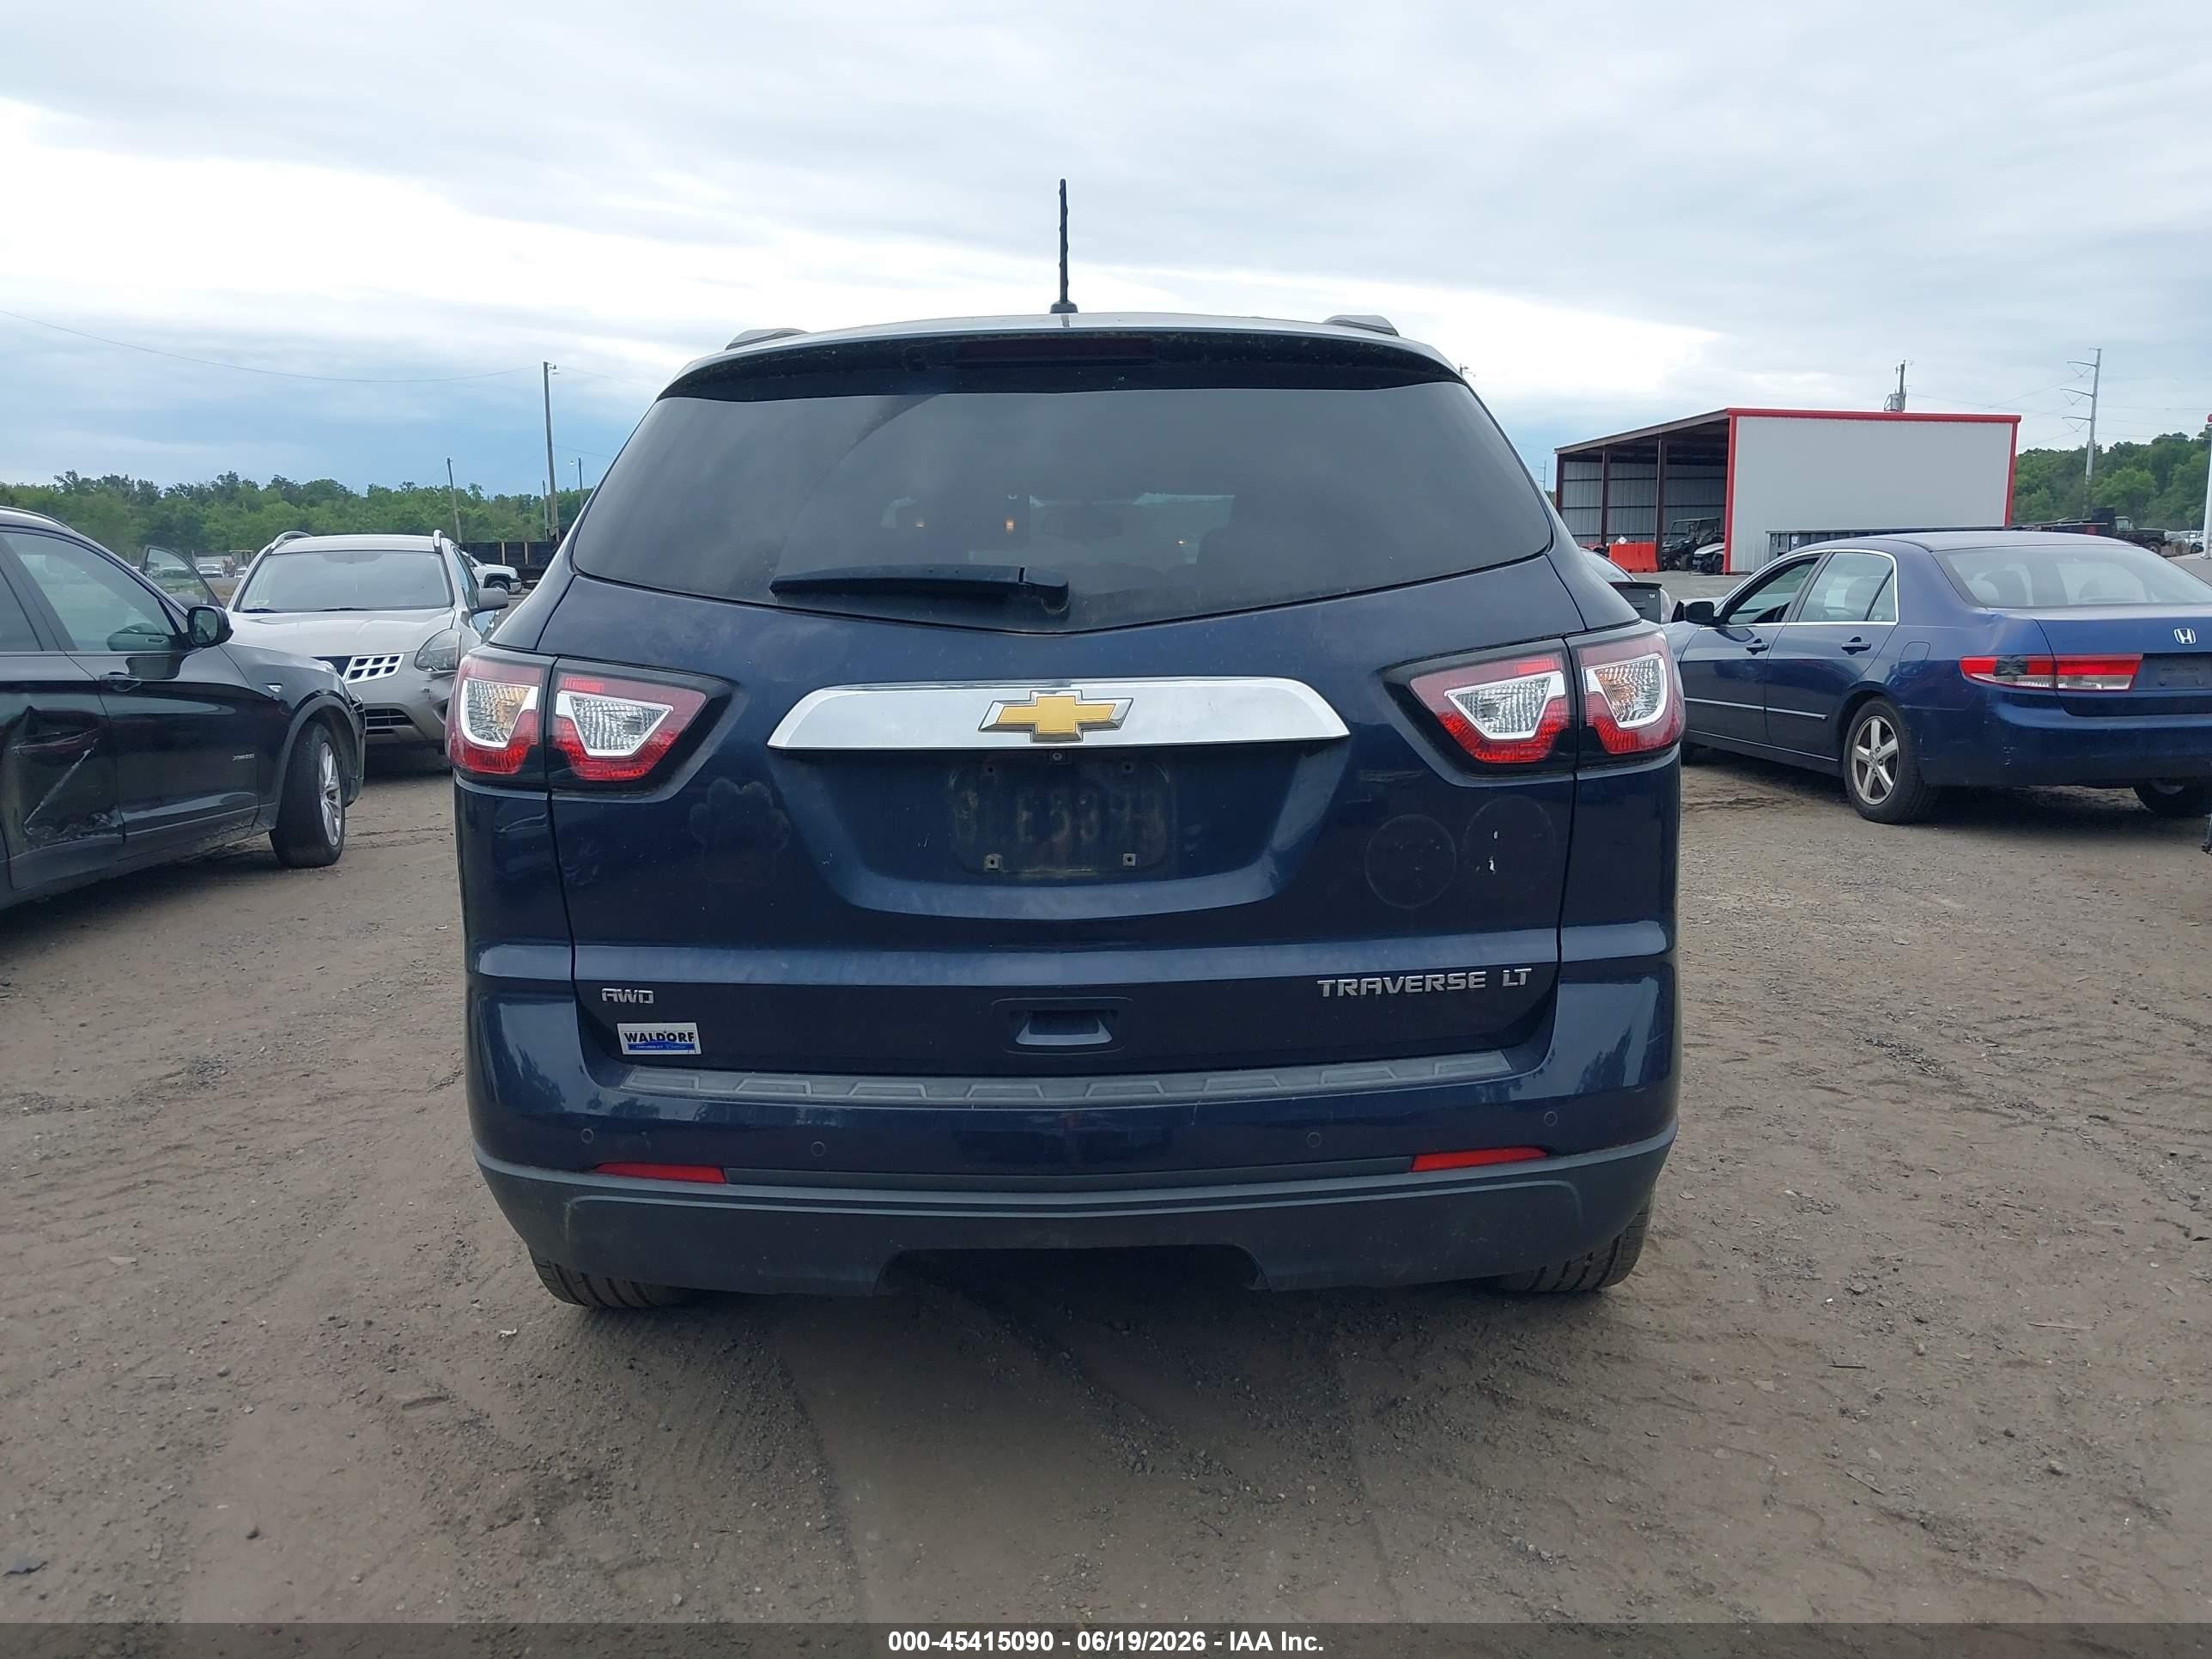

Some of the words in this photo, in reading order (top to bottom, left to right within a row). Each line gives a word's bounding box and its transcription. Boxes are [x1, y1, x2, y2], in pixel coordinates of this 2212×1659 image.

[1316, 970, 1486, 997] TRAVERSE
[1502, 968, 1532, 988] LT
[601, 988, 654, 1004] AWD
[623, 1031, 695, 1042] WALDORF
